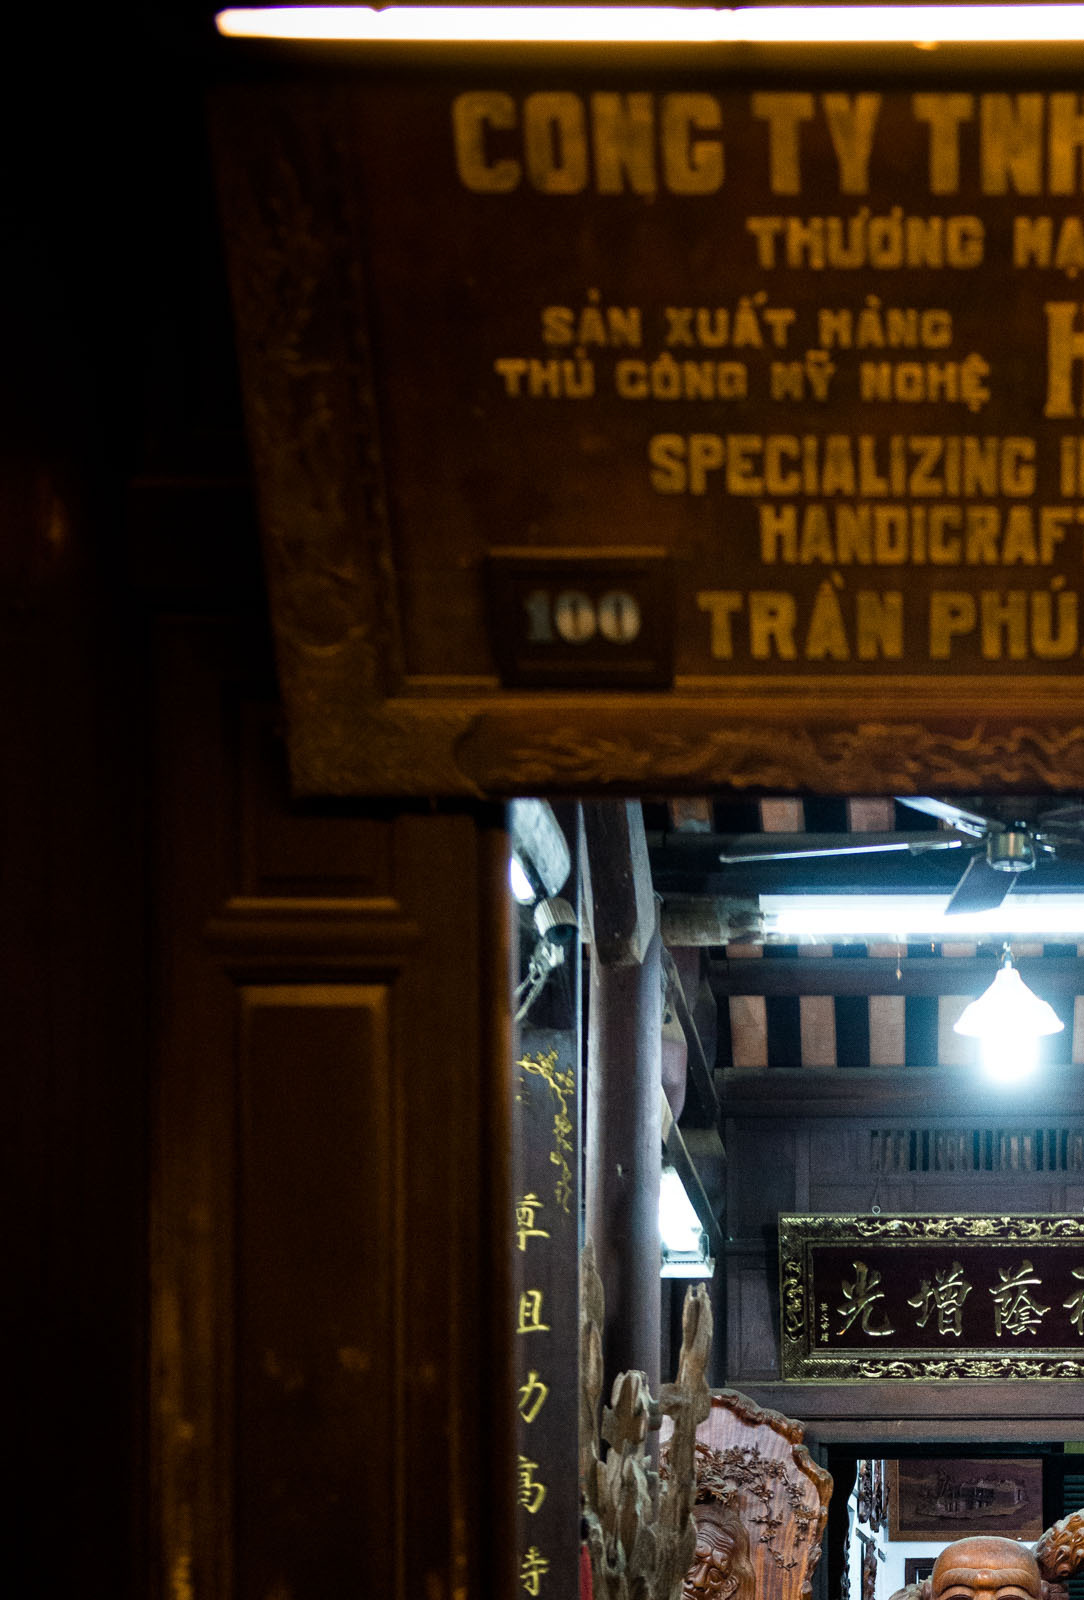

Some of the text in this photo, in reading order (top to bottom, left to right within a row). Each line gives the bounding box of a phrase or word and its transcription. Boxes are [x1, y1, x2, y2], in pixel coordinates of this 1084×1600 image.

[752, 91, 882, 195] TY
[616, 352, 748, 400] CÔNG
[861, 353, 992, 412] NGHỆ
[649, 434, 1037, 497] SPECIALIZING
[526, 588, 642, 645] 100
